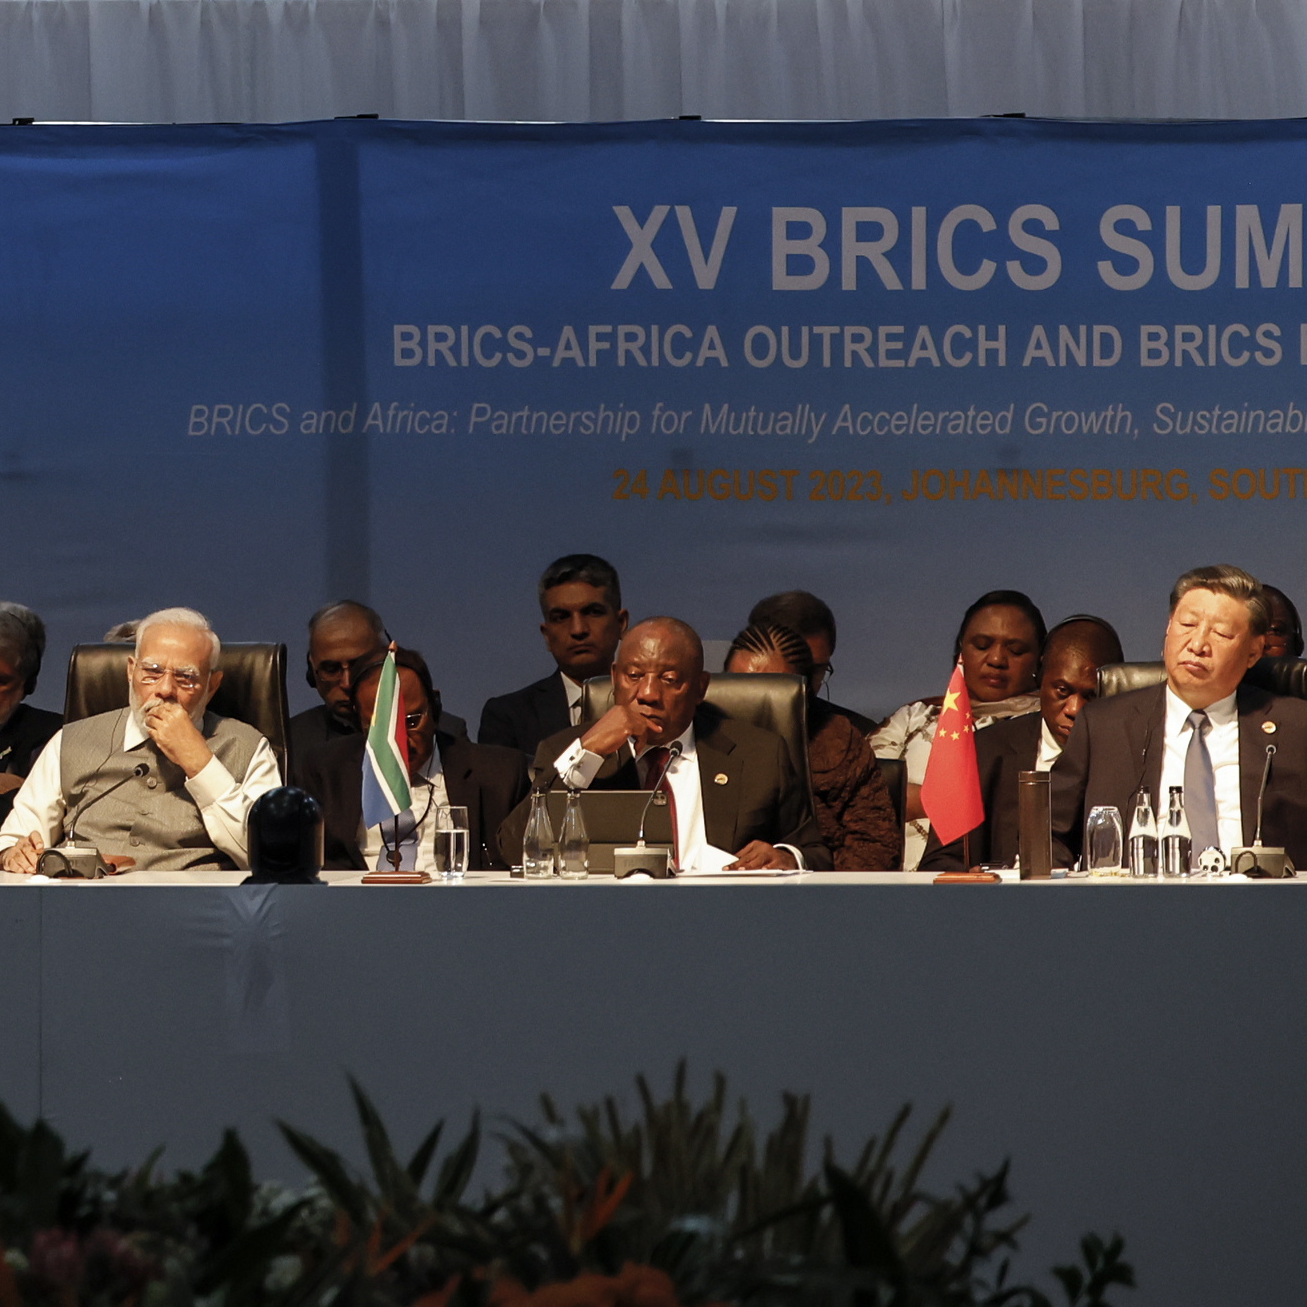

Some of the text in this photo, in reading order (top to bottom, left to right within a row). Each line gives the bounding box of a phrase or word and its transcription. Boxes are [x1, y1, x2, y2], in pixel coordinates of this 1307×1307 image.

[610, 203, 1304, 292] XV BRICS SUM
[392, 323, 729, 368] BRICS-AFRICA
[743, 324, 1007, 369] OUTREACH
[1022, 324, 1123, 368] AND
[1139, 322, 1283, 368] BRICS
[187, 401, 1307, 443] BRICS and Africa: Partnership for Mutually Accelerated Growth, Sustainab
[612, 467, 1307, 505] 24 AUGUST 2023, JOHANNESBURG, SOUT
